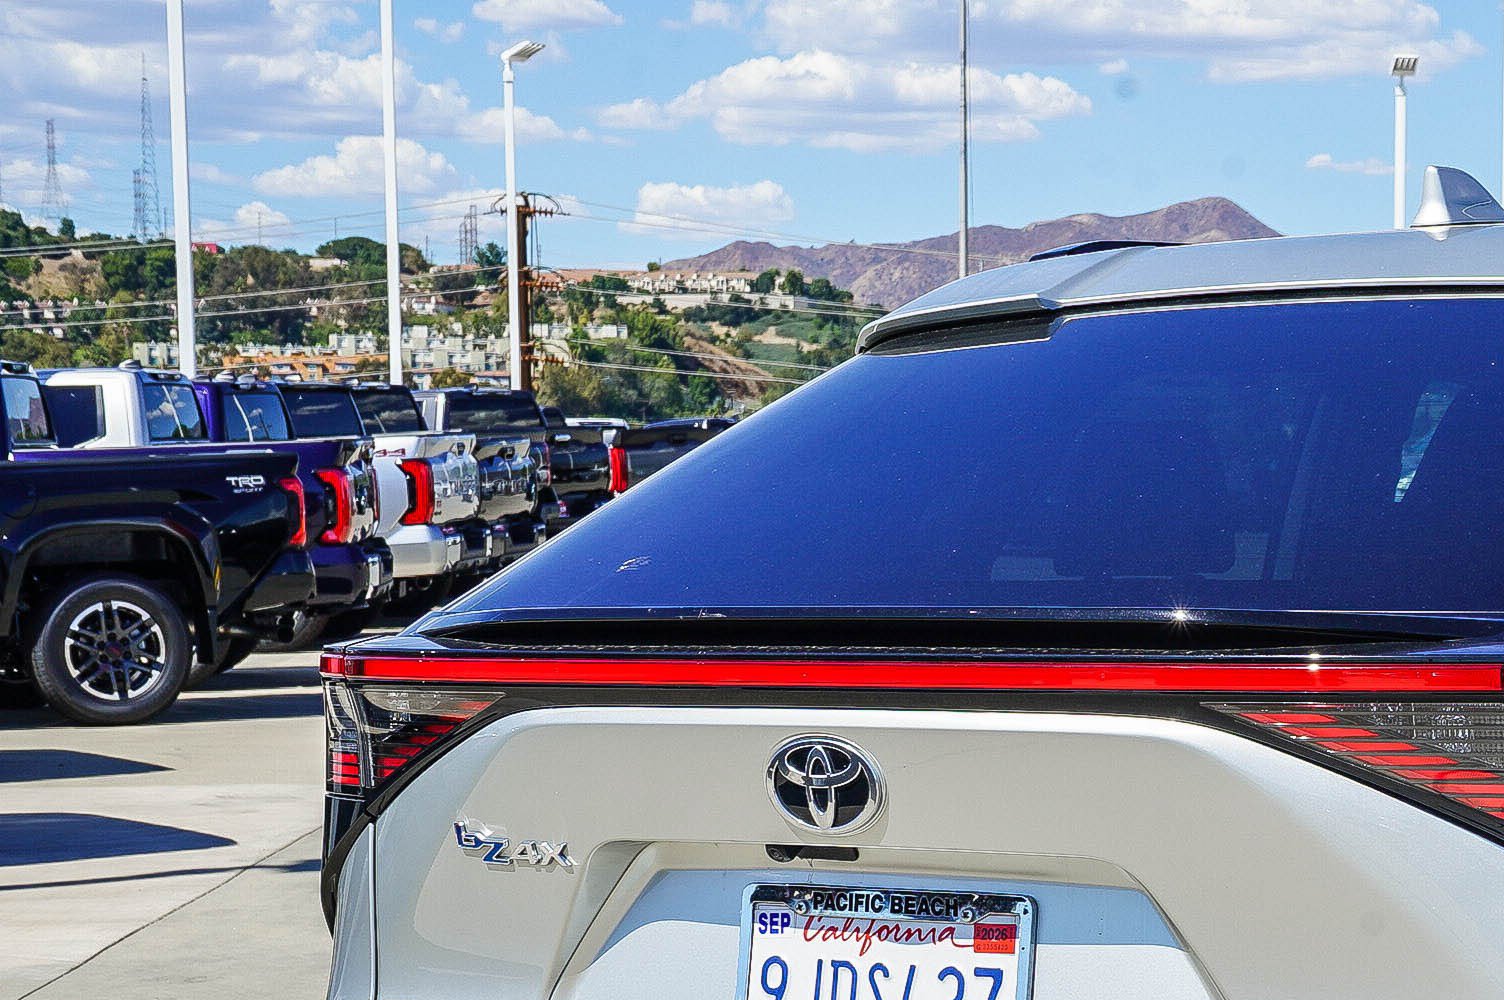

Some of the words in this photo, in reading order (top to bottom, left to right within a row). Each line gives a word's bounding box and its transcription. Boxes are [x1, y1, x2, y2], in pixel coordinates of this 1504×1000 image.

[226, 475, 265, 487] TRD
[812, 891, 884, 913] PACIFIC
[889, 894, 959, 917] BEACH
[758, 912, 791, 934] SEP
[981, 927, 1008, 941] 2026
[803, 915, 974, 956] California
